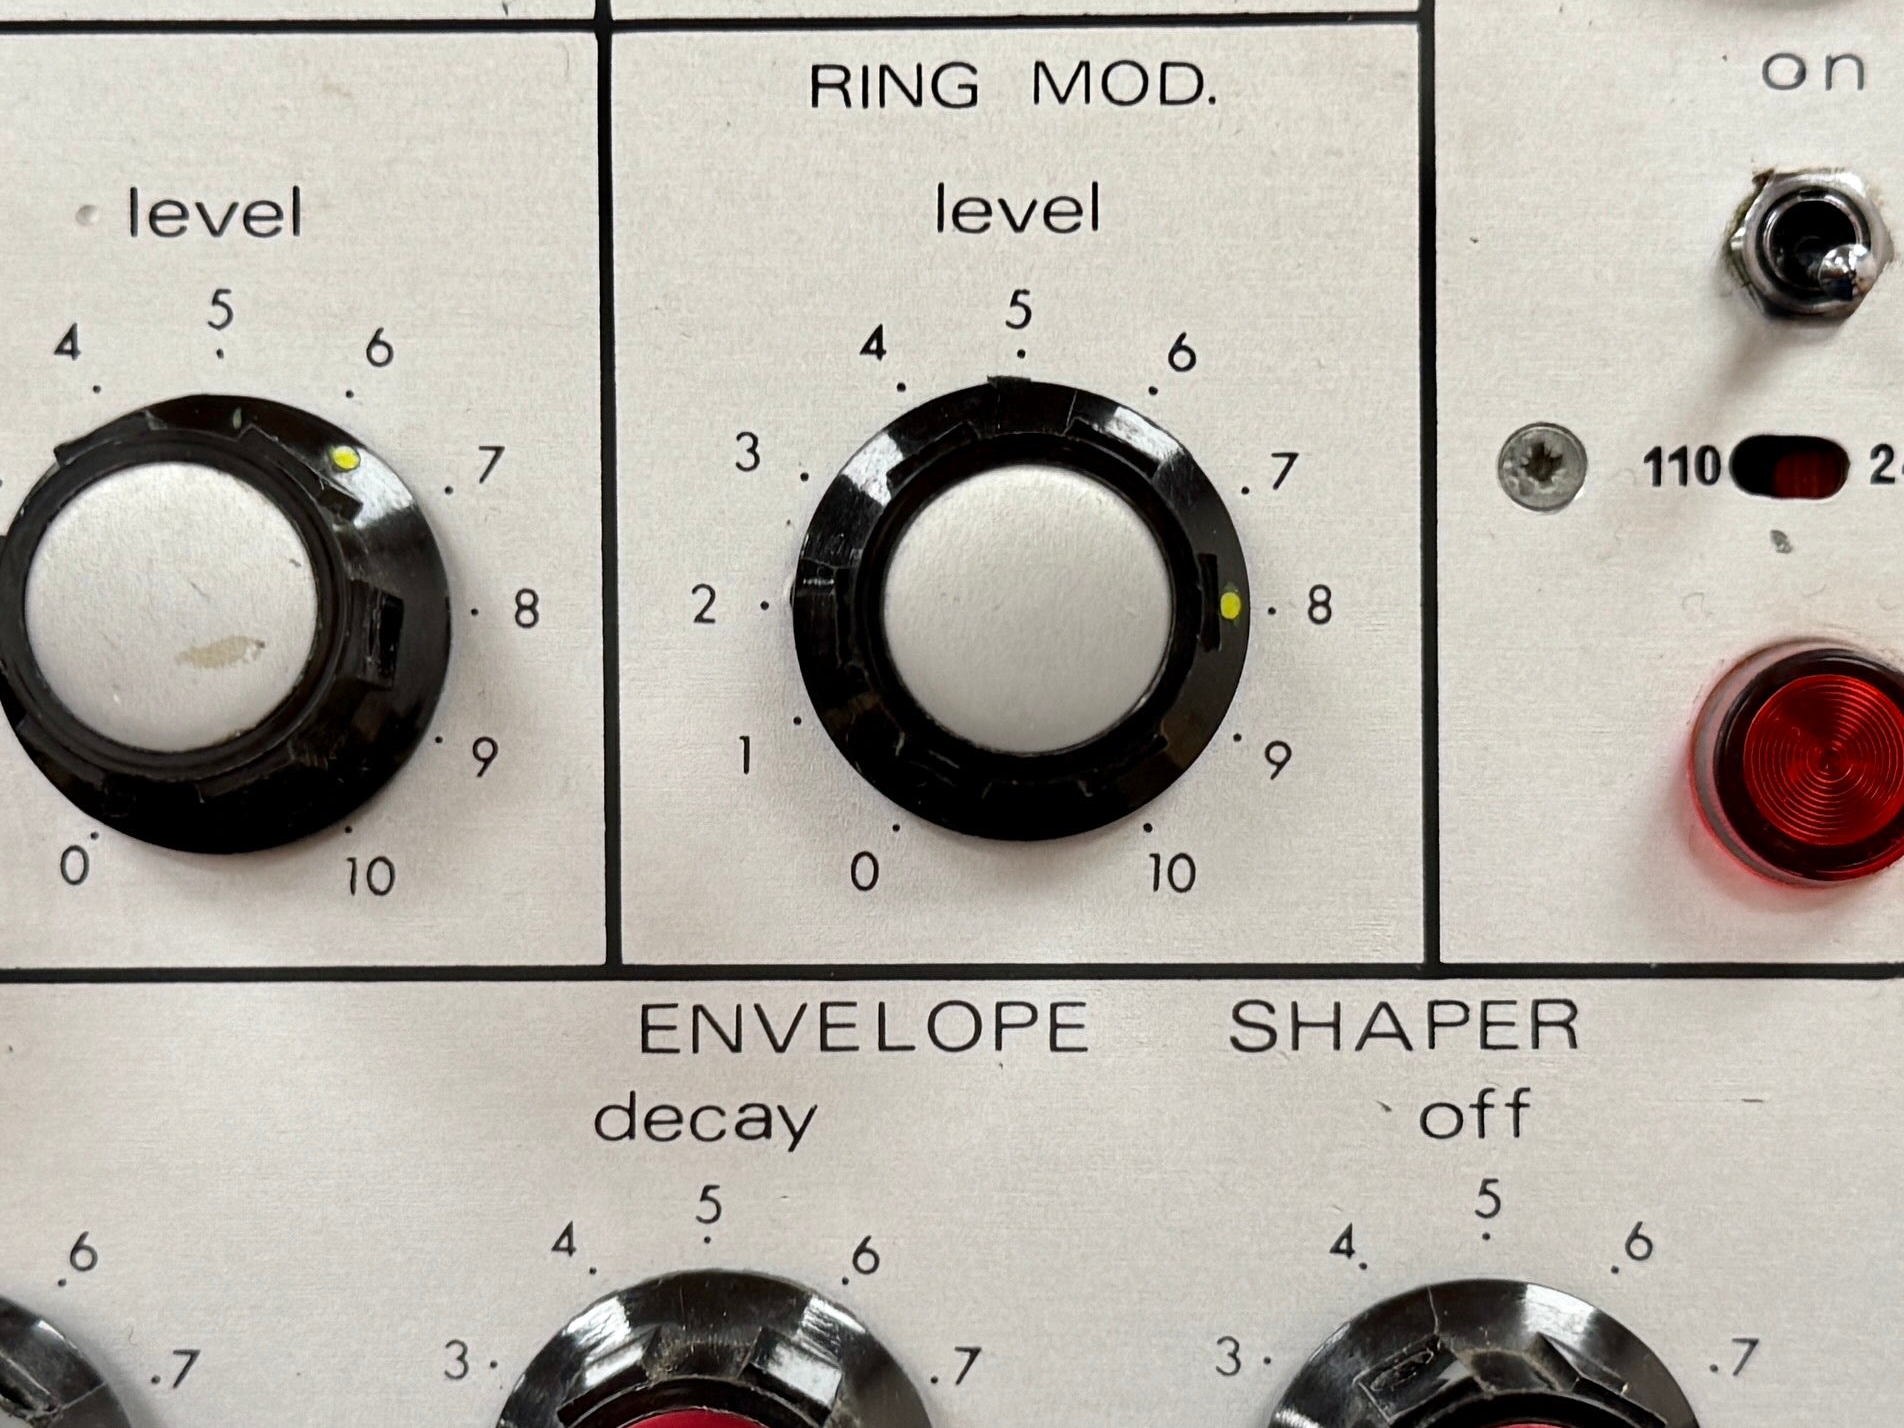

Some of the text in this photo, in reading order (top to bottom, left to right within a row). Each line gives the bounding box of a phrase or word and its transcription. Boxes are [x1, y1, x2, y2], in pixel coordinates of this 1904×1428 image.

[811, 58, 1216, 110] RING MOD.
[1762, 51, 1867, 91] on
[128, 184, 301, 239] level
[937, 180, 1099, 234] level
[1005, 288, 1032, 331] 5
[366, 327, 394, 368] 6
[735, 431, 760, 473] 3
[1641, 444, 1721, 488] 110
[1307, 584, 1333, 626] 8
[345, 855, 396, 897] 10
[851, 850, 879, 893] 0
[641, 998, 1579, 1061] ENVELOPE SHAPER
[594, 1090, 818, 1153] decay
[1419, 1079, 1532, 1140] off
[695, 1184, 722, 1225] 5
[69, 1231, 98, 1273] 6
[1624, 1221, 1655, 1263] 6
[1216, 1336, 1242, 1377] 3
